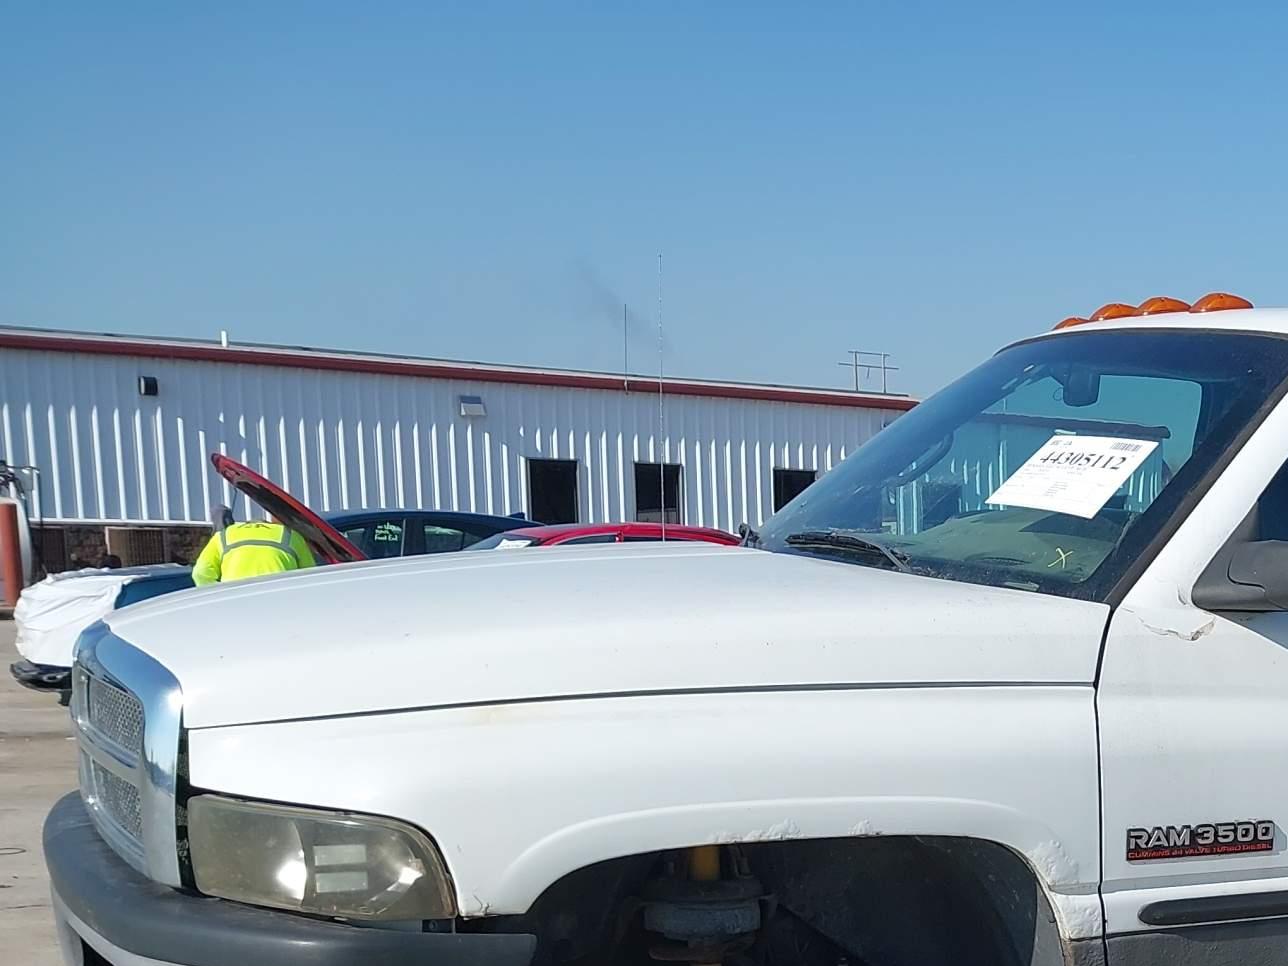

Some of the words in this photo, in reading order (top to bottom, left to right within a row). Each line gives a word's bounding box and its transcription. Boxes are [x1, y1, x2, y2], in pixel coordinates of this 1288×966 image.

[1040, 450, 1127, 470] 44305112
[1129, 825, 1191, 849] RAM
[1196, 821, 1274, 845] 3500
[1128, 851, 1170, 859] CUMMINS
